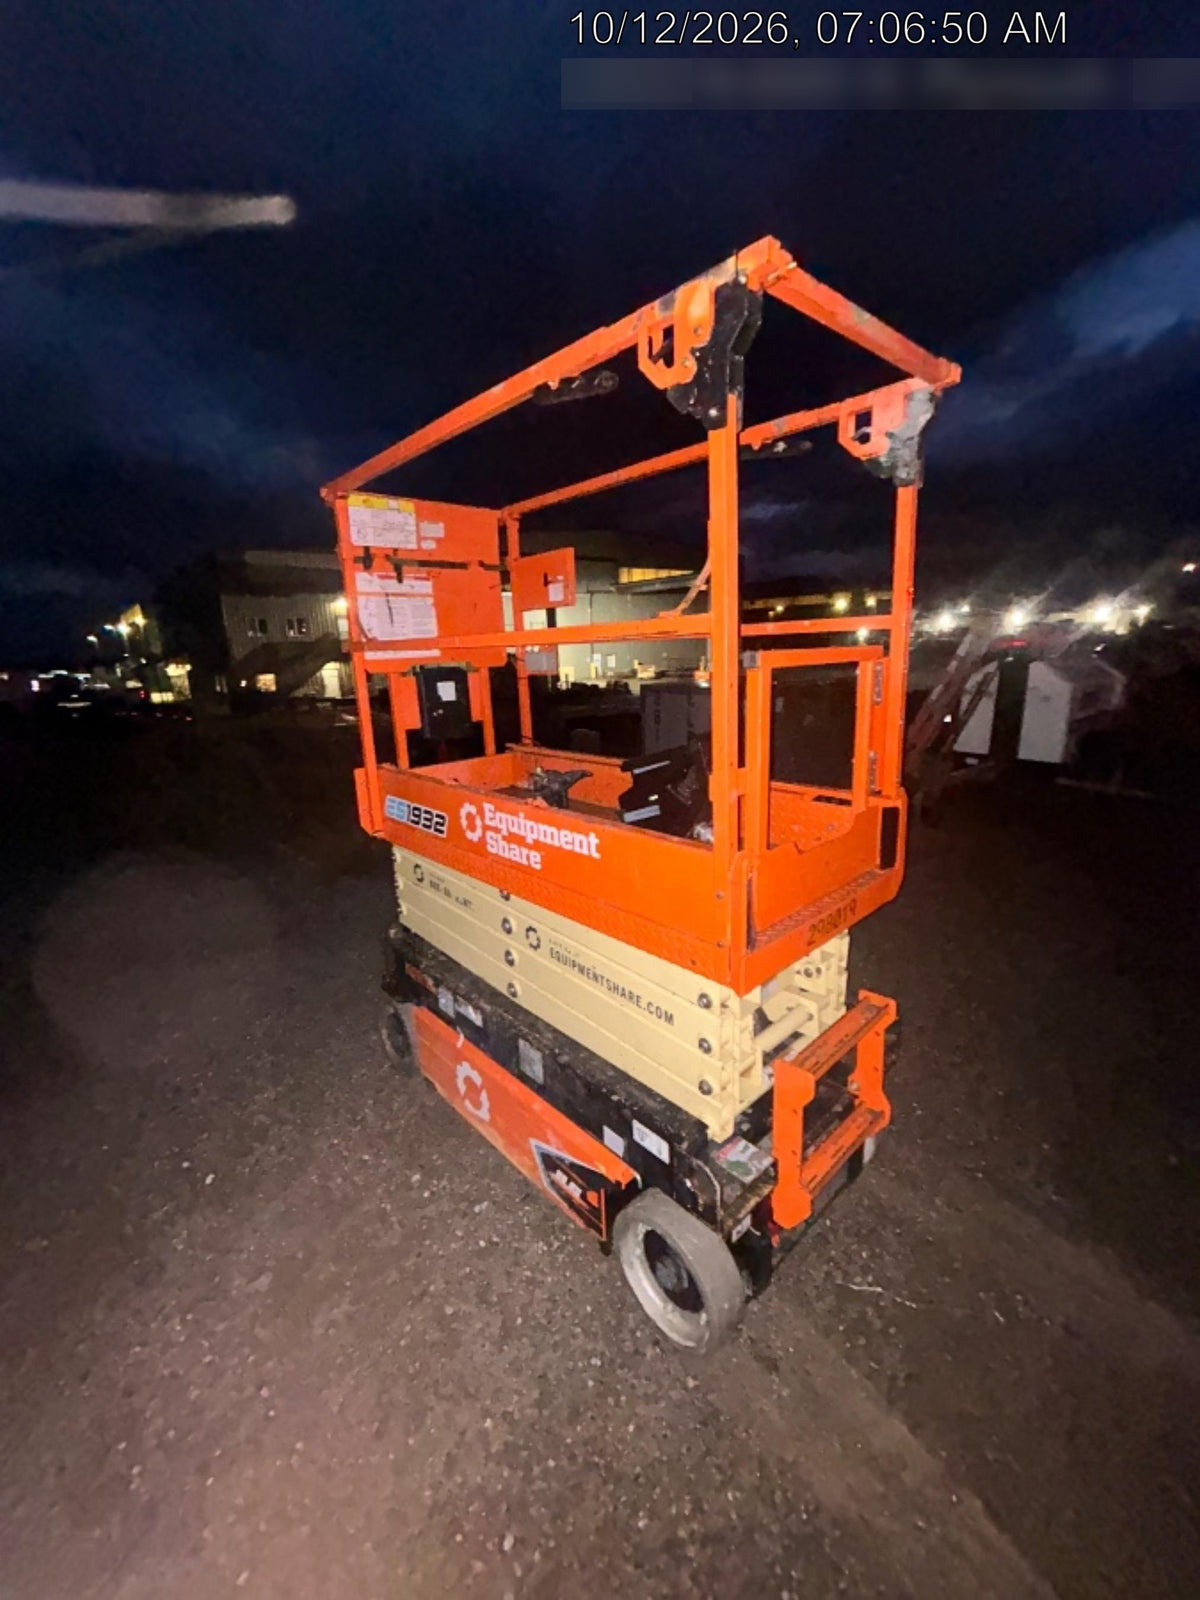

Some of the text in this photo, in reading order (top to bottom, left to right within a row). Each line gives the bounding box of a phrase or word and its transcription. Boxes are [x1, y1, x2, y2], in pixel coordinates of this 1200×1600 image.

[386, 798, 447, 835] ES1932
[483, 802, 601, 859] Equipment
[485, 830, 542, 870] Share
[549, 947, 675, 1026] EQUIPMENTSHARE.COM
